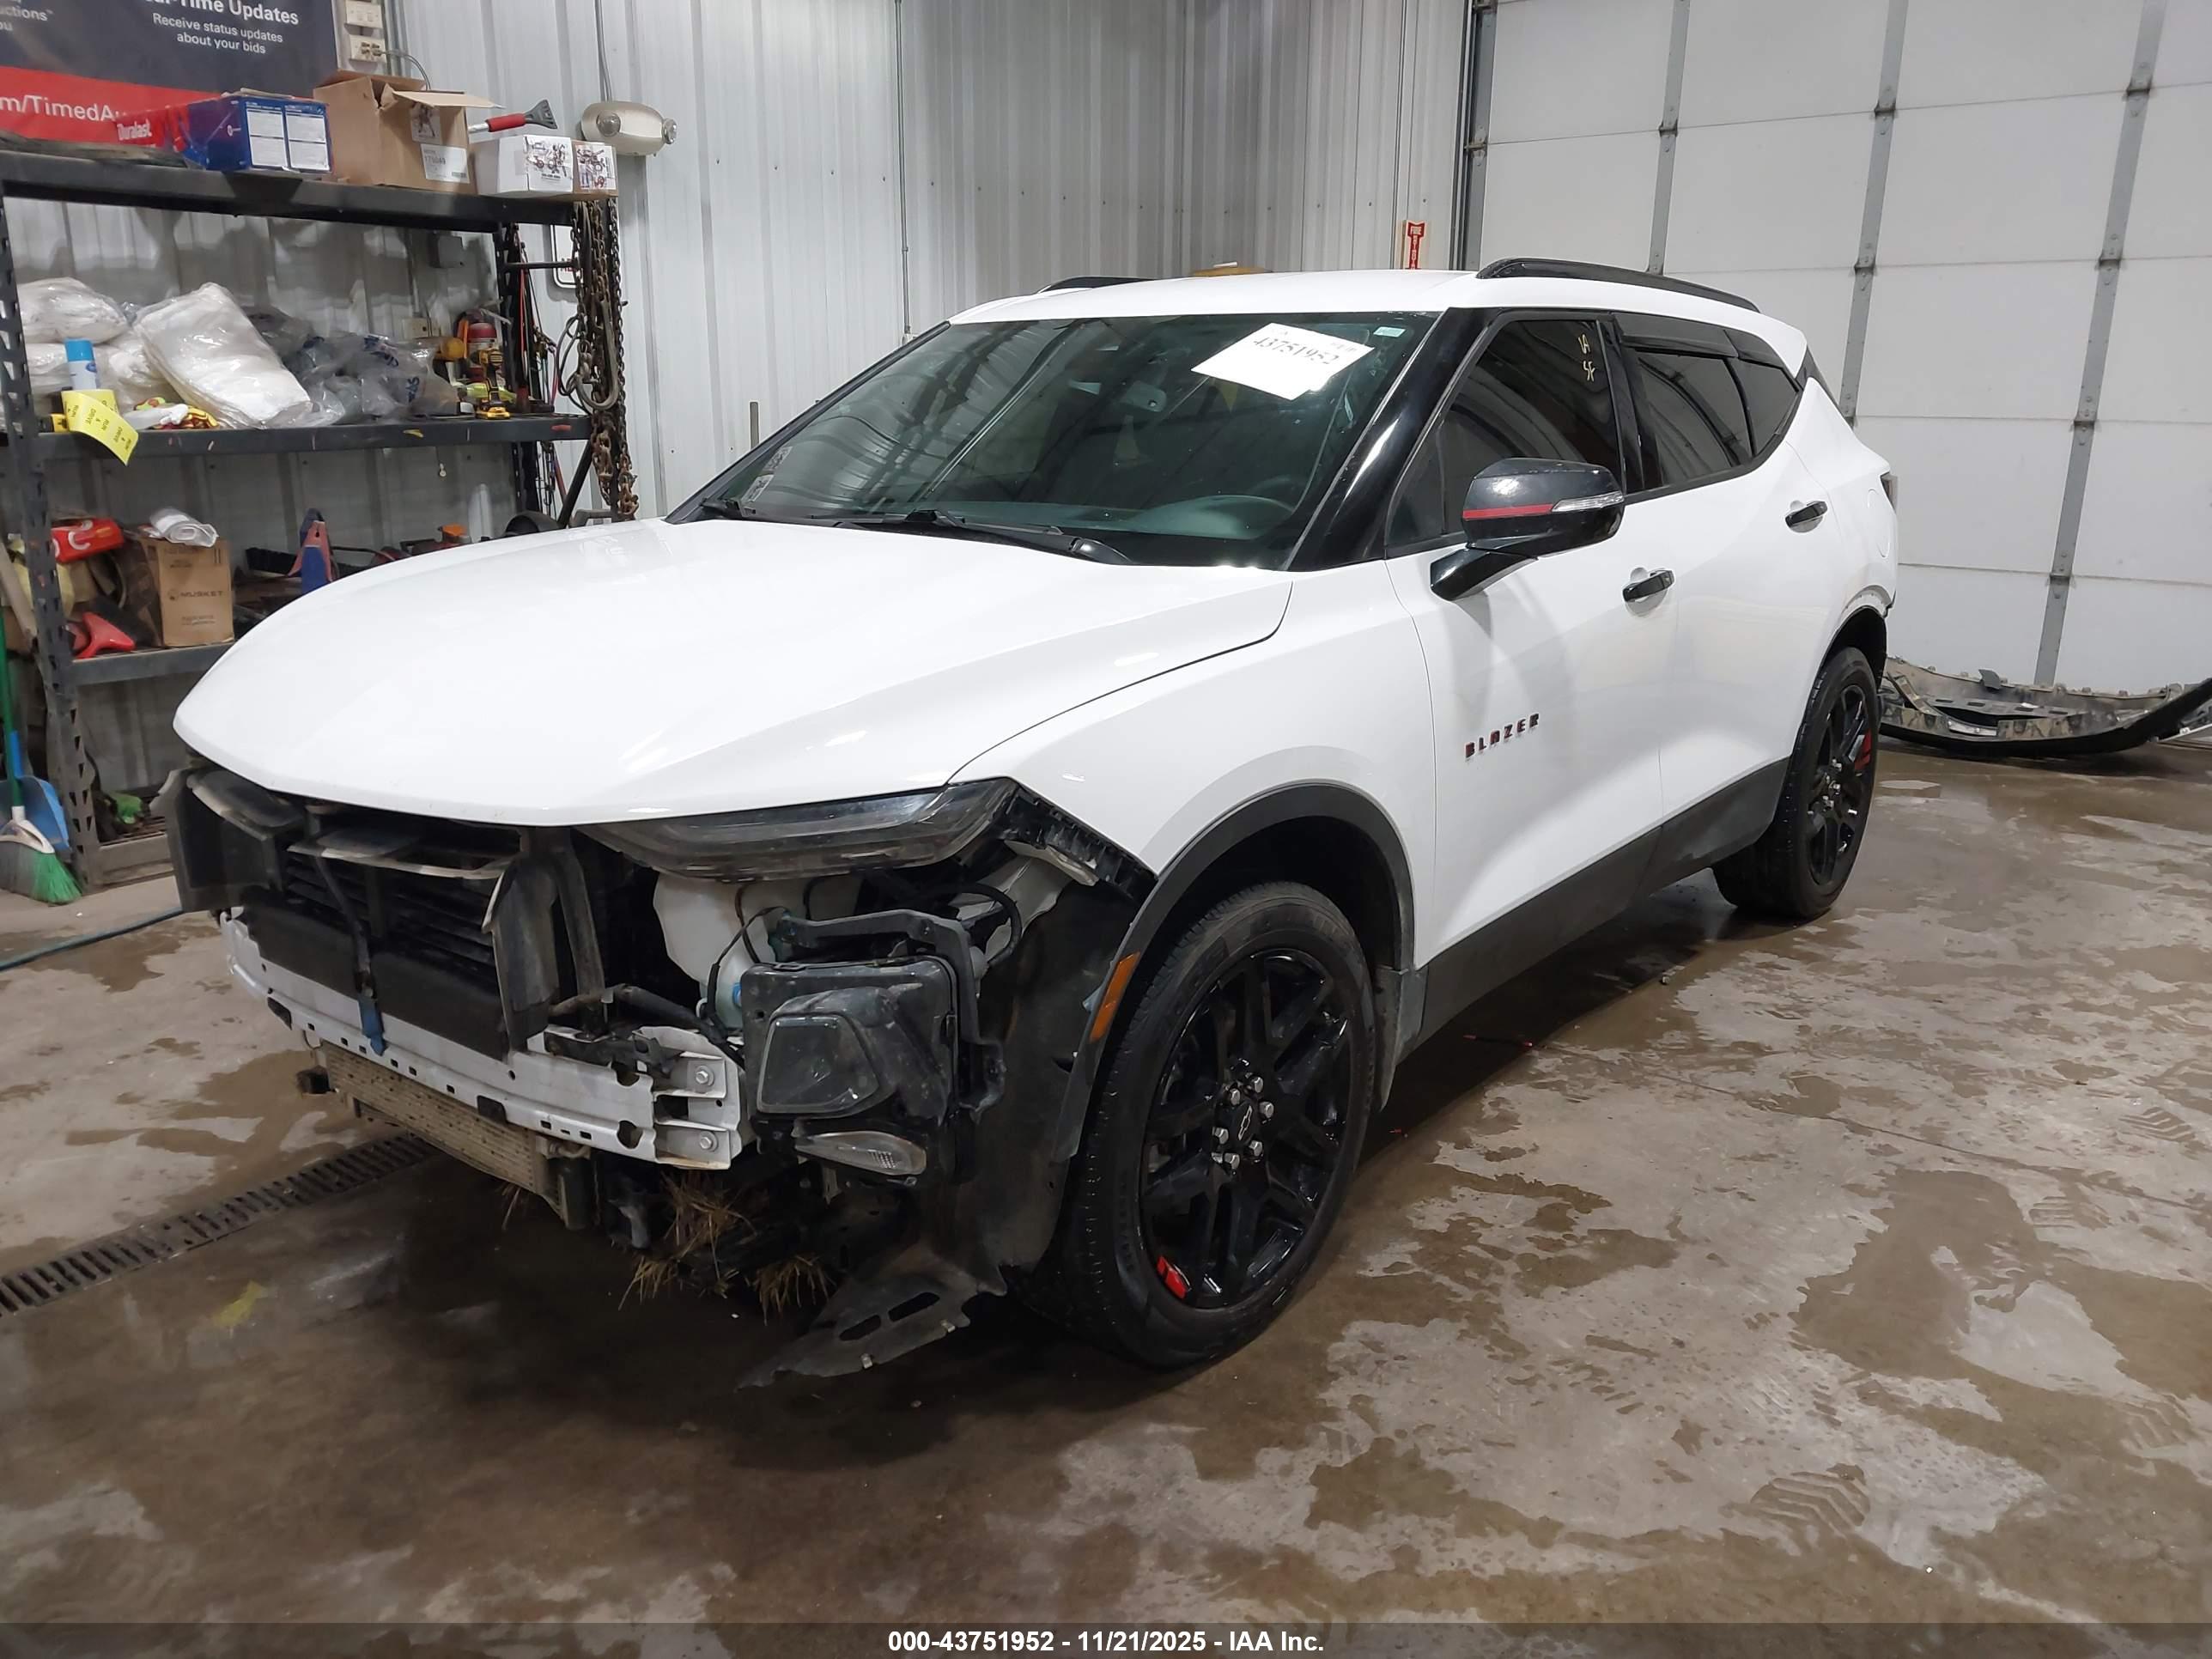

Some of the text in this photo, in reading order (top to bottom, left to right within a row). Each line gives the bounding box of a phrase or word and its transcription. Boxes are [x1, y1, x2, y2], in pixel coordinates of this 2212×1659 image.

[229, 0, 300, 25] Updates
[153, 13, 283, 43] Receive status updates
[177, 32, 266, 54] about your bids
[0, 94, 126, 122] m/TimedA
[1253, 337, 1340, 365] 43751952
[1464, 713, 1540, 759] BLAZER
